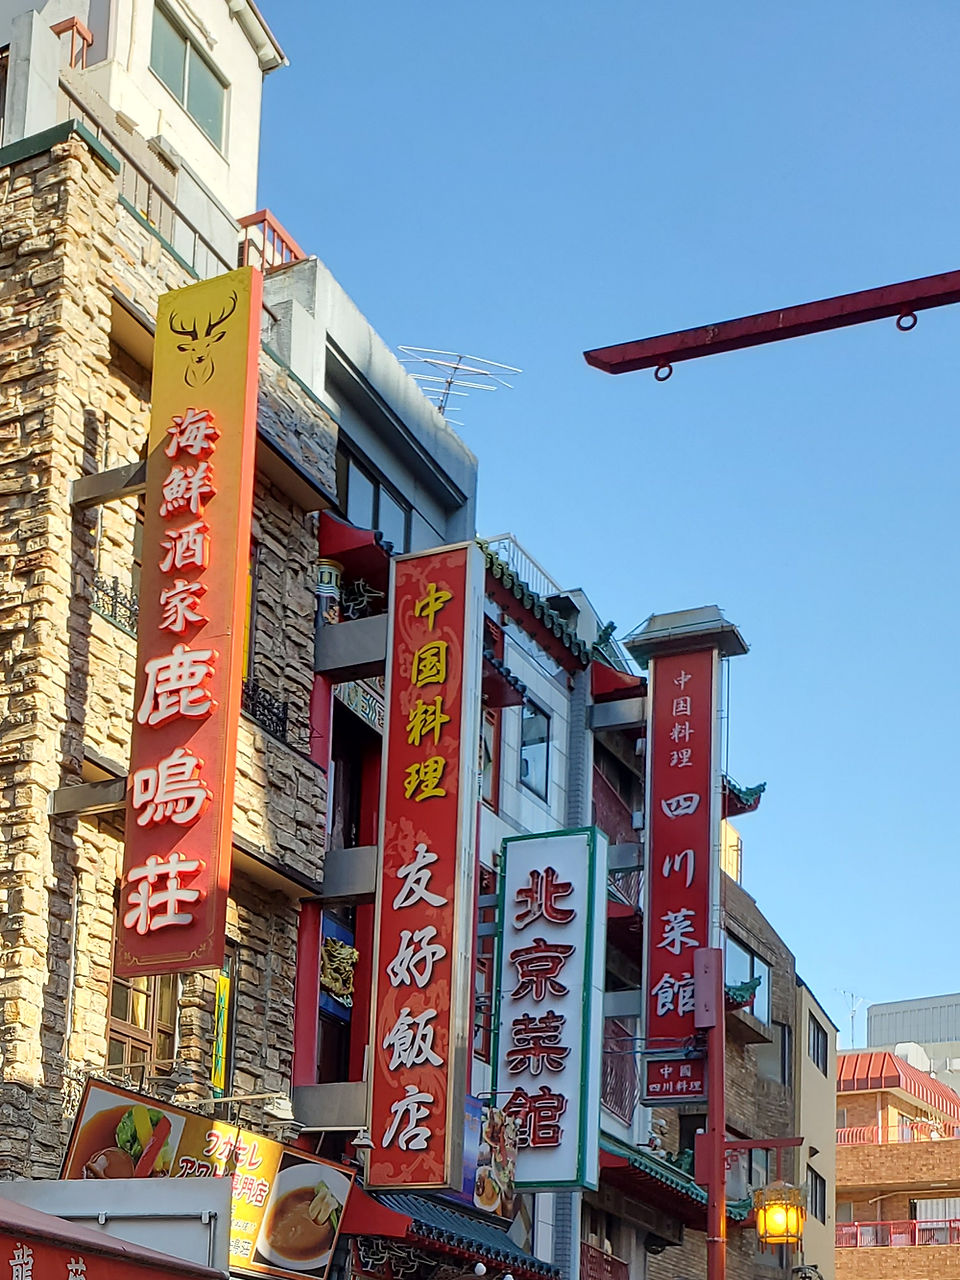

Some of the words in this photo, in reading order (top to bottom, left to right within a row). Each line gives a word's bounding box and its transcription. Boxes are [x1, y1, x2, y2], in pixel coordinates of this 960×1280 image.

[159, 407, 215, 632] 海鮮酒家
[124, 645, 215, 936] 鹿鳴荘
[403, 583, 452, 803] 中国料理
[670, 669, 695, 768] 中国料理
[382, 843, 449, 1152] 友好飯店
[651, 790, 700, 1018] 四川菜館
[648, 1080, 702, 1093] 四川料理
